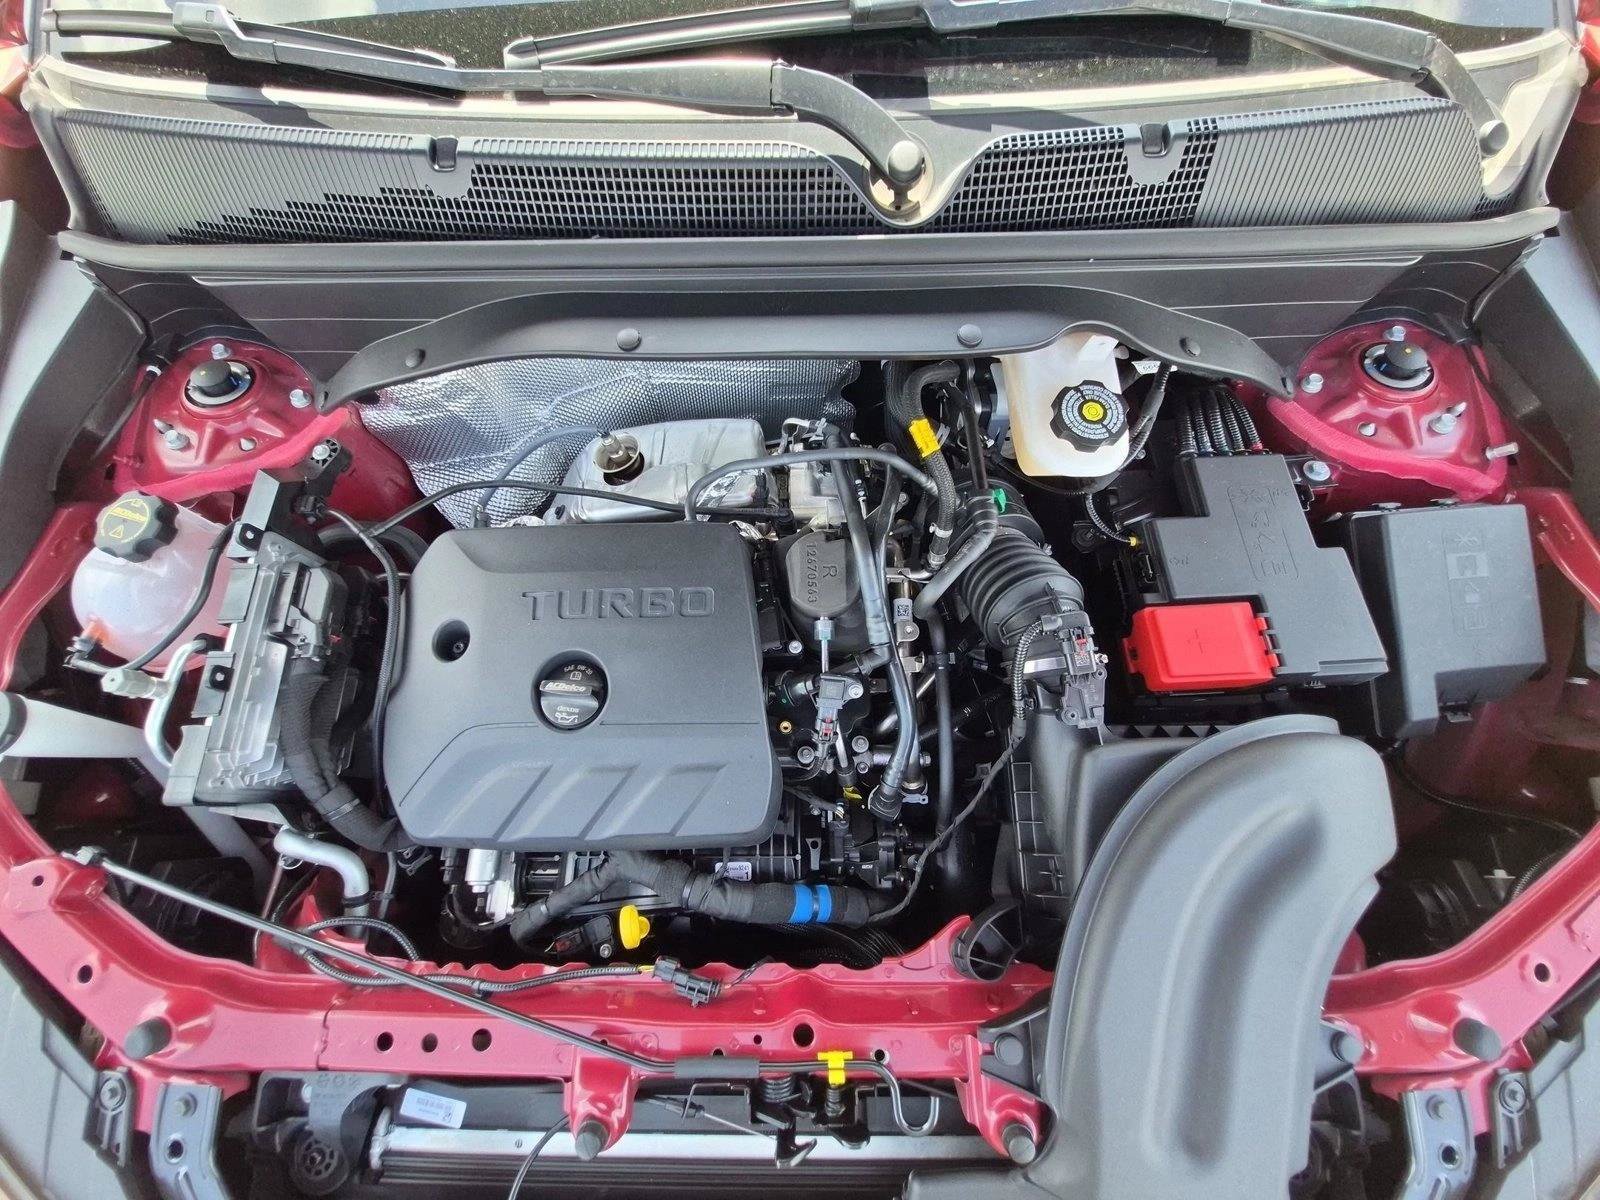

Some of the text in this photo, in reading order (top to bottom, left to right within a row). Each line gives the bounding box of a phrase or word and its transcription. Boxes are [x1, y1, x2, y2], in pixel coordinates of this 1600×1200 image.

[807, 544, 817, 603] 12670563
[822, 565, 838, 578] R
[521, 586, 715, 621] TURBO
[545, 682, 587, 692] ACDelco
